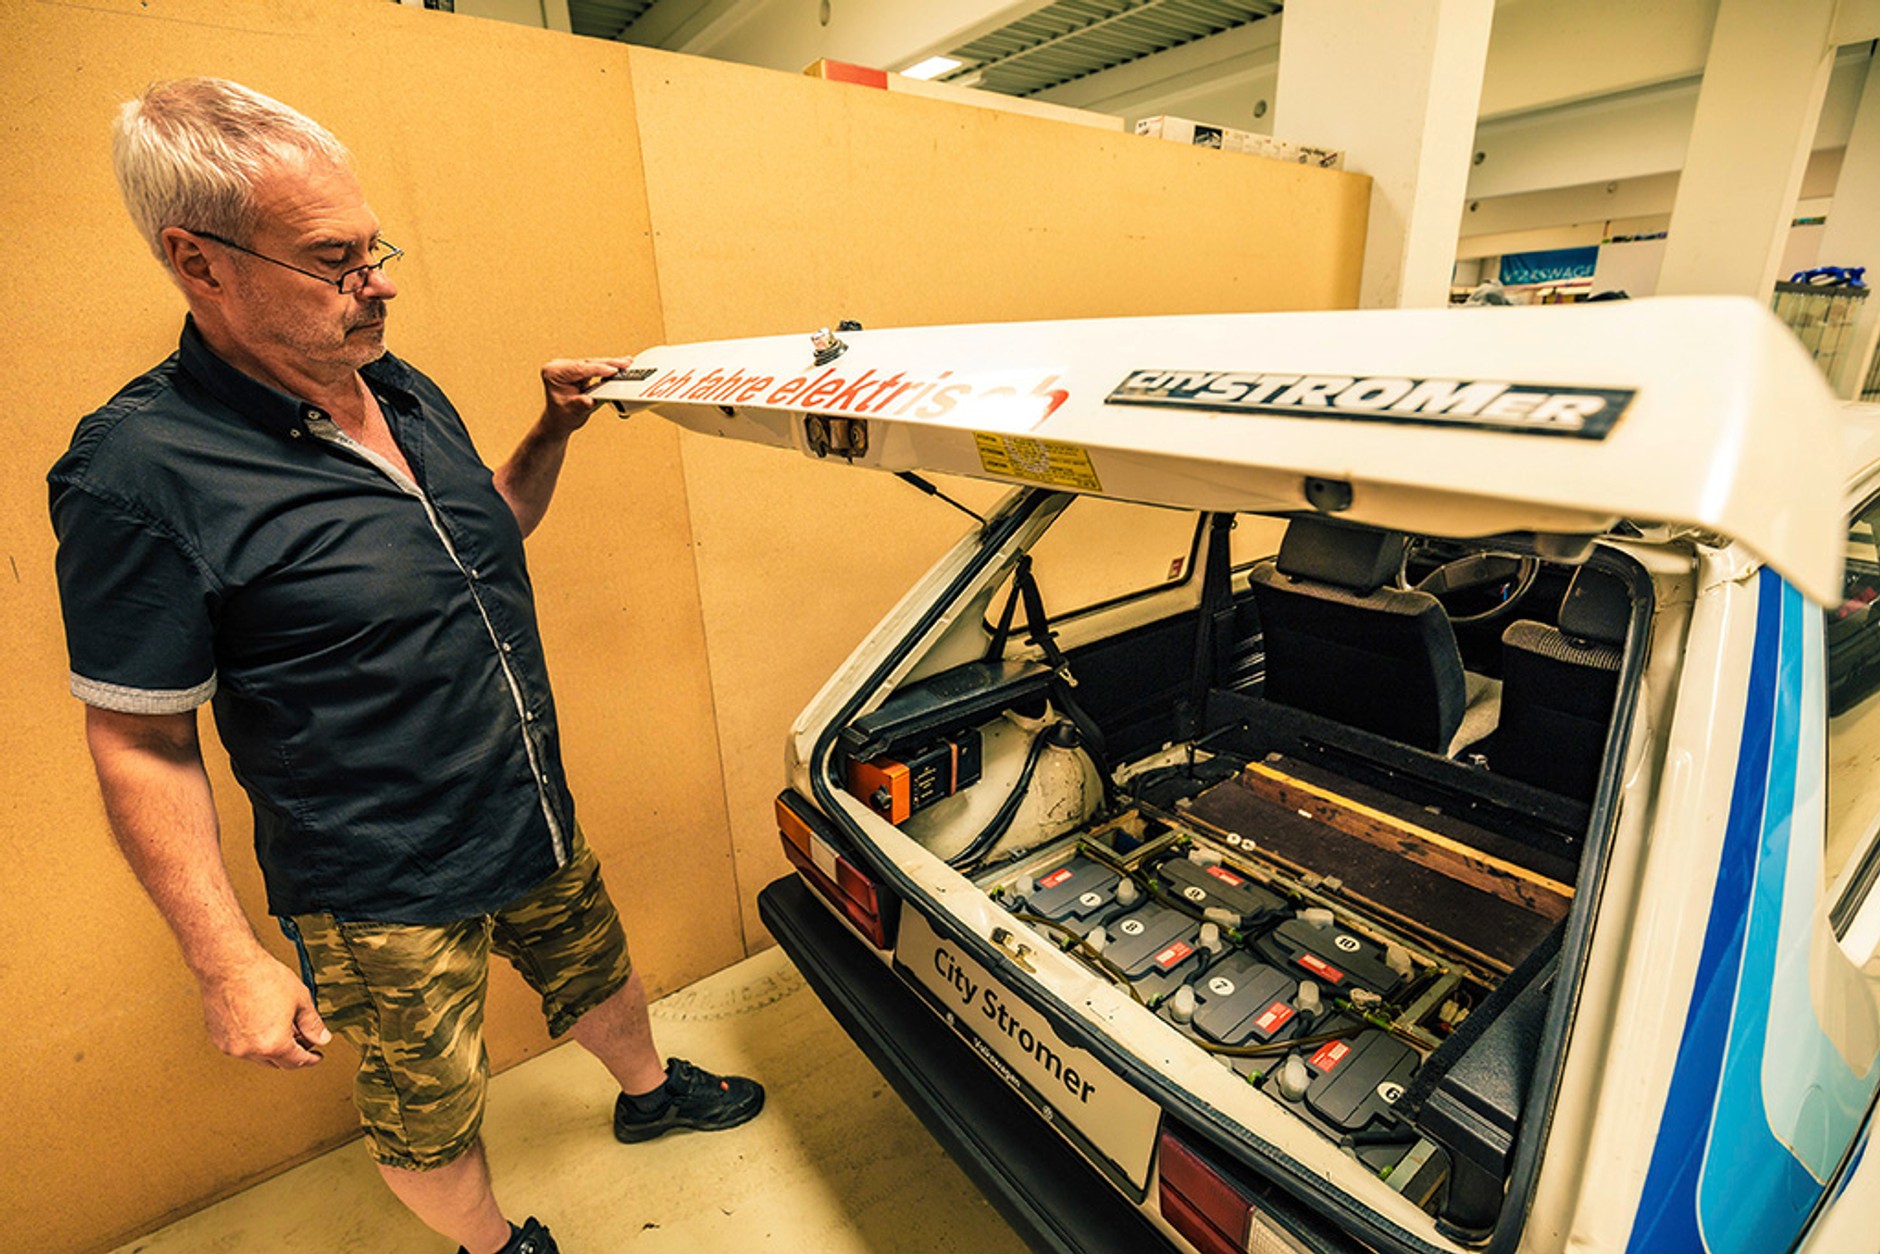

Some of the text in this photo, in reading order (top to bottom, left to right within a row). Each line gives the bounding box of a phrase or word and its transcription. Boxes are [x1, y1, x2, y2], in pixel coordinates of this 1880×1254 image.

[639, 368, 697, 398] Ich
[679, 367, 775, 402] fahre
[1120, 369, 1607, 431] CITYSTROMER
[933, 947, 1096, 1104] City Stromer
